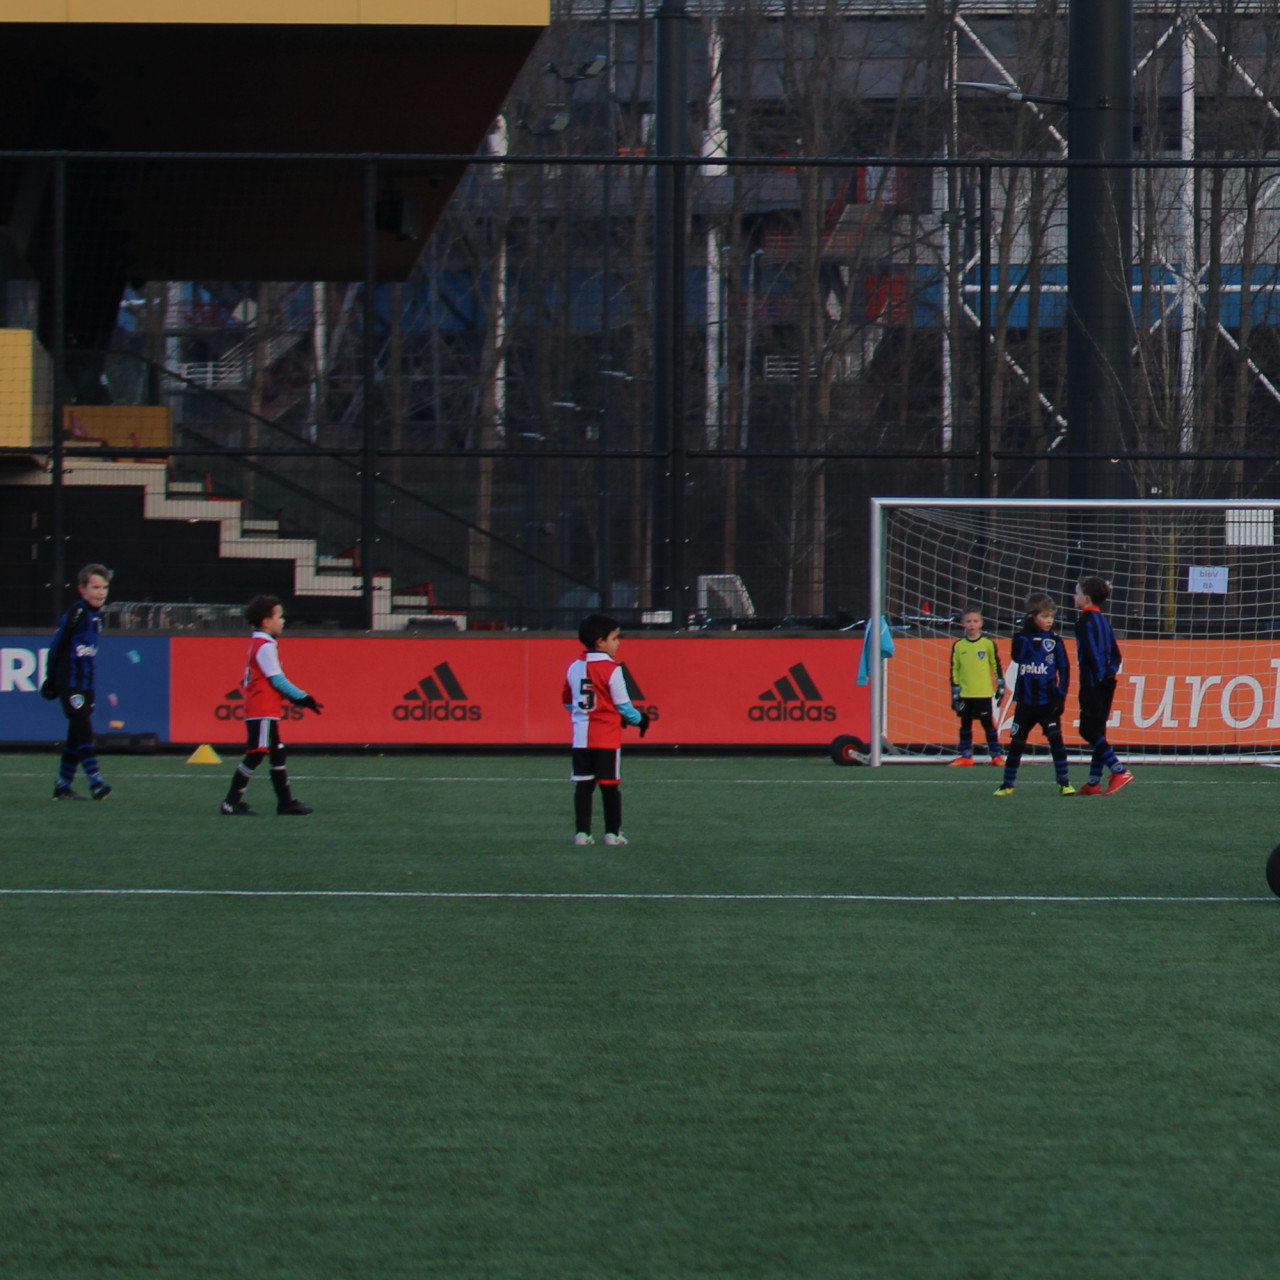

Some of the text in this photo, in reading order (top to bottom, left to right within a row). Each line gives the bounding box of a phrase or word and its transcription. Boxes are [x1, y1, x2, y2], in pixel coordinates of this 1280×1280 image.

[1019, 662, 1049, 678] geluk
[578, 678, 597, 712] 5
[393, 700, 482, 722] adidas
[748, 700, 837, 722] adidas
